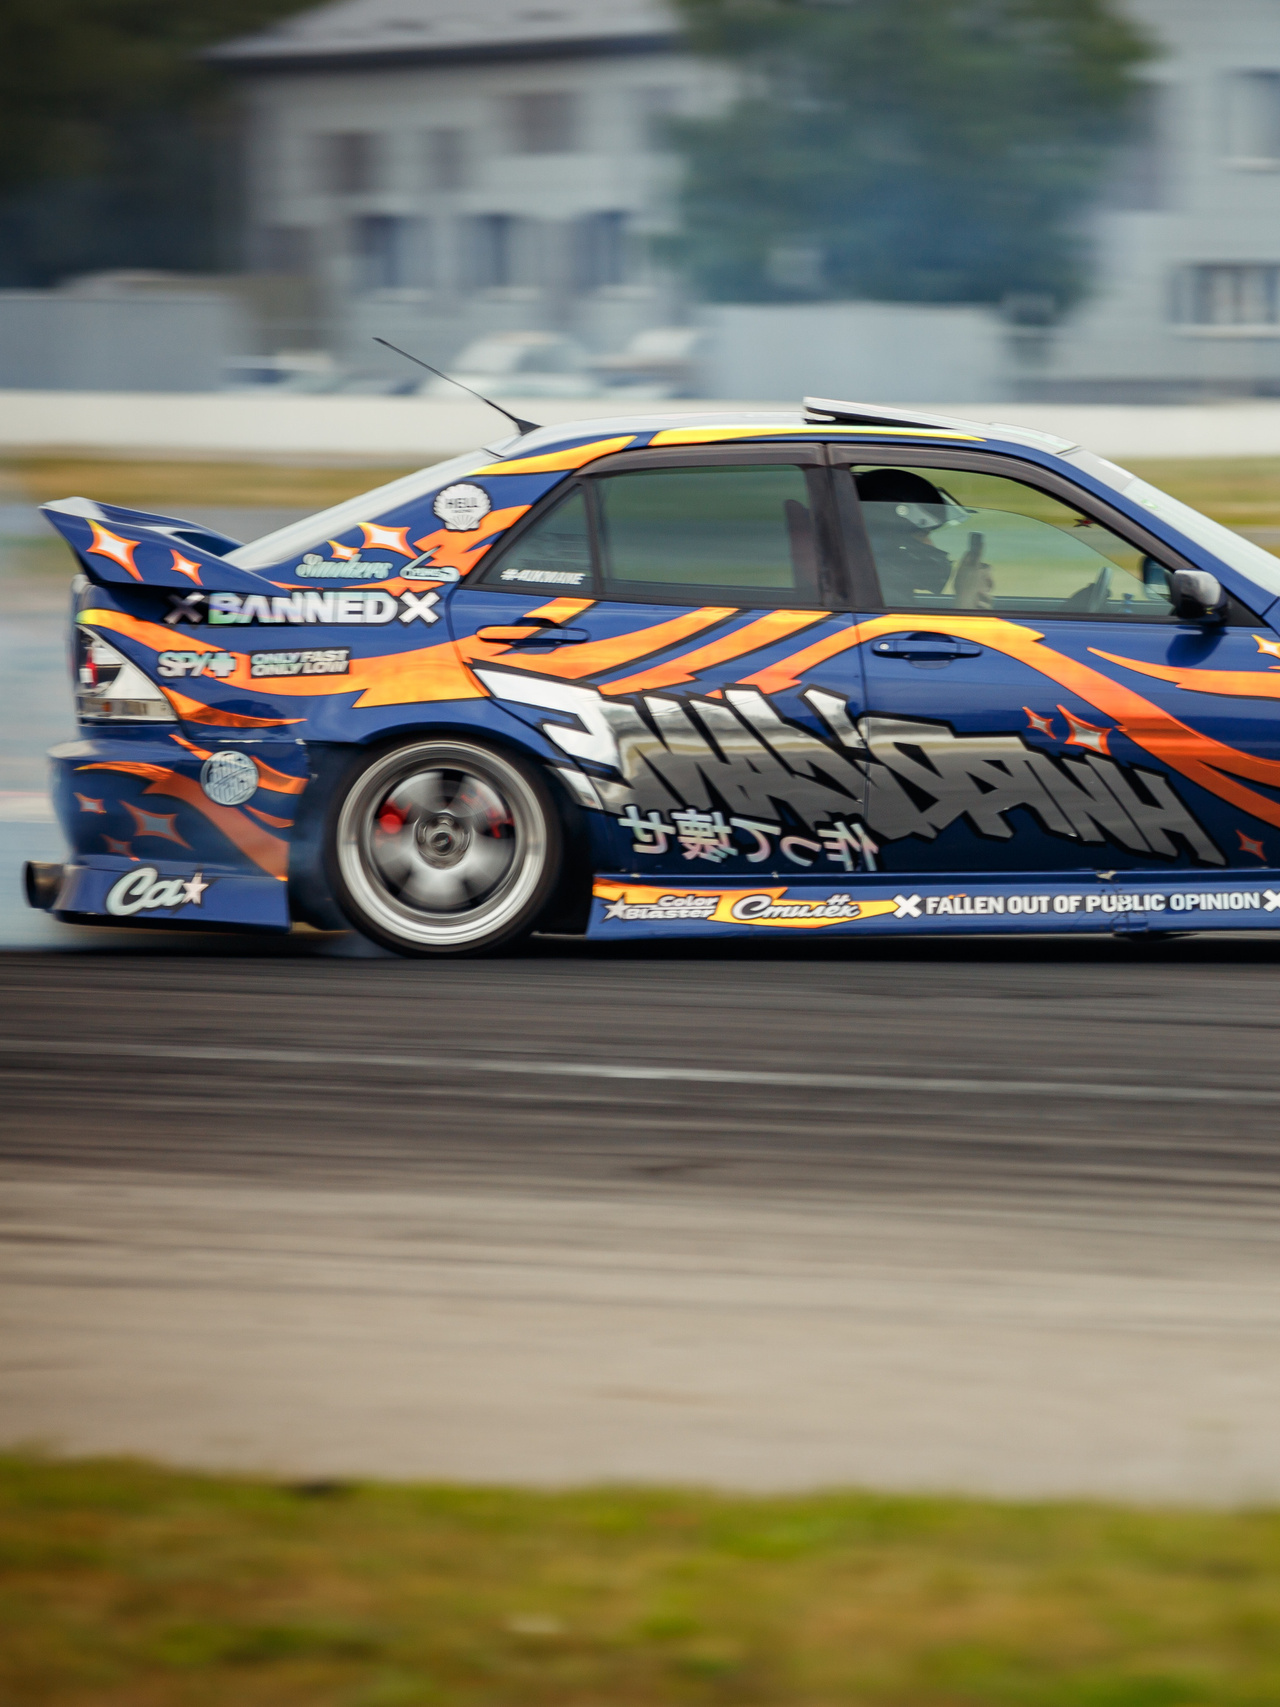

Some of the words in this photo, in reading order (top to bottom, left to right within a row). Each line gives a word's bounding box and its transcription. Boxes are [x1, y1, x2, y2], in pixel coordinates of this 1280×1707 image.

[208, 591, 398, 624] BANNED
[251, 653, 301, 665] ONLY
[251, 662, 303, 676] ONLY
[658, 895, 719, 907] Color
[926, 896, 1003, 914] FALLEN
[1007, 896, 1050, 914] OUT
[1053, 895, 1082, 913] OF
[1085, 894, 1166, 912] PUBLIC
[1170, 892, 1260, 911] OPINION
[623, 908, 715, 919] Blaster
